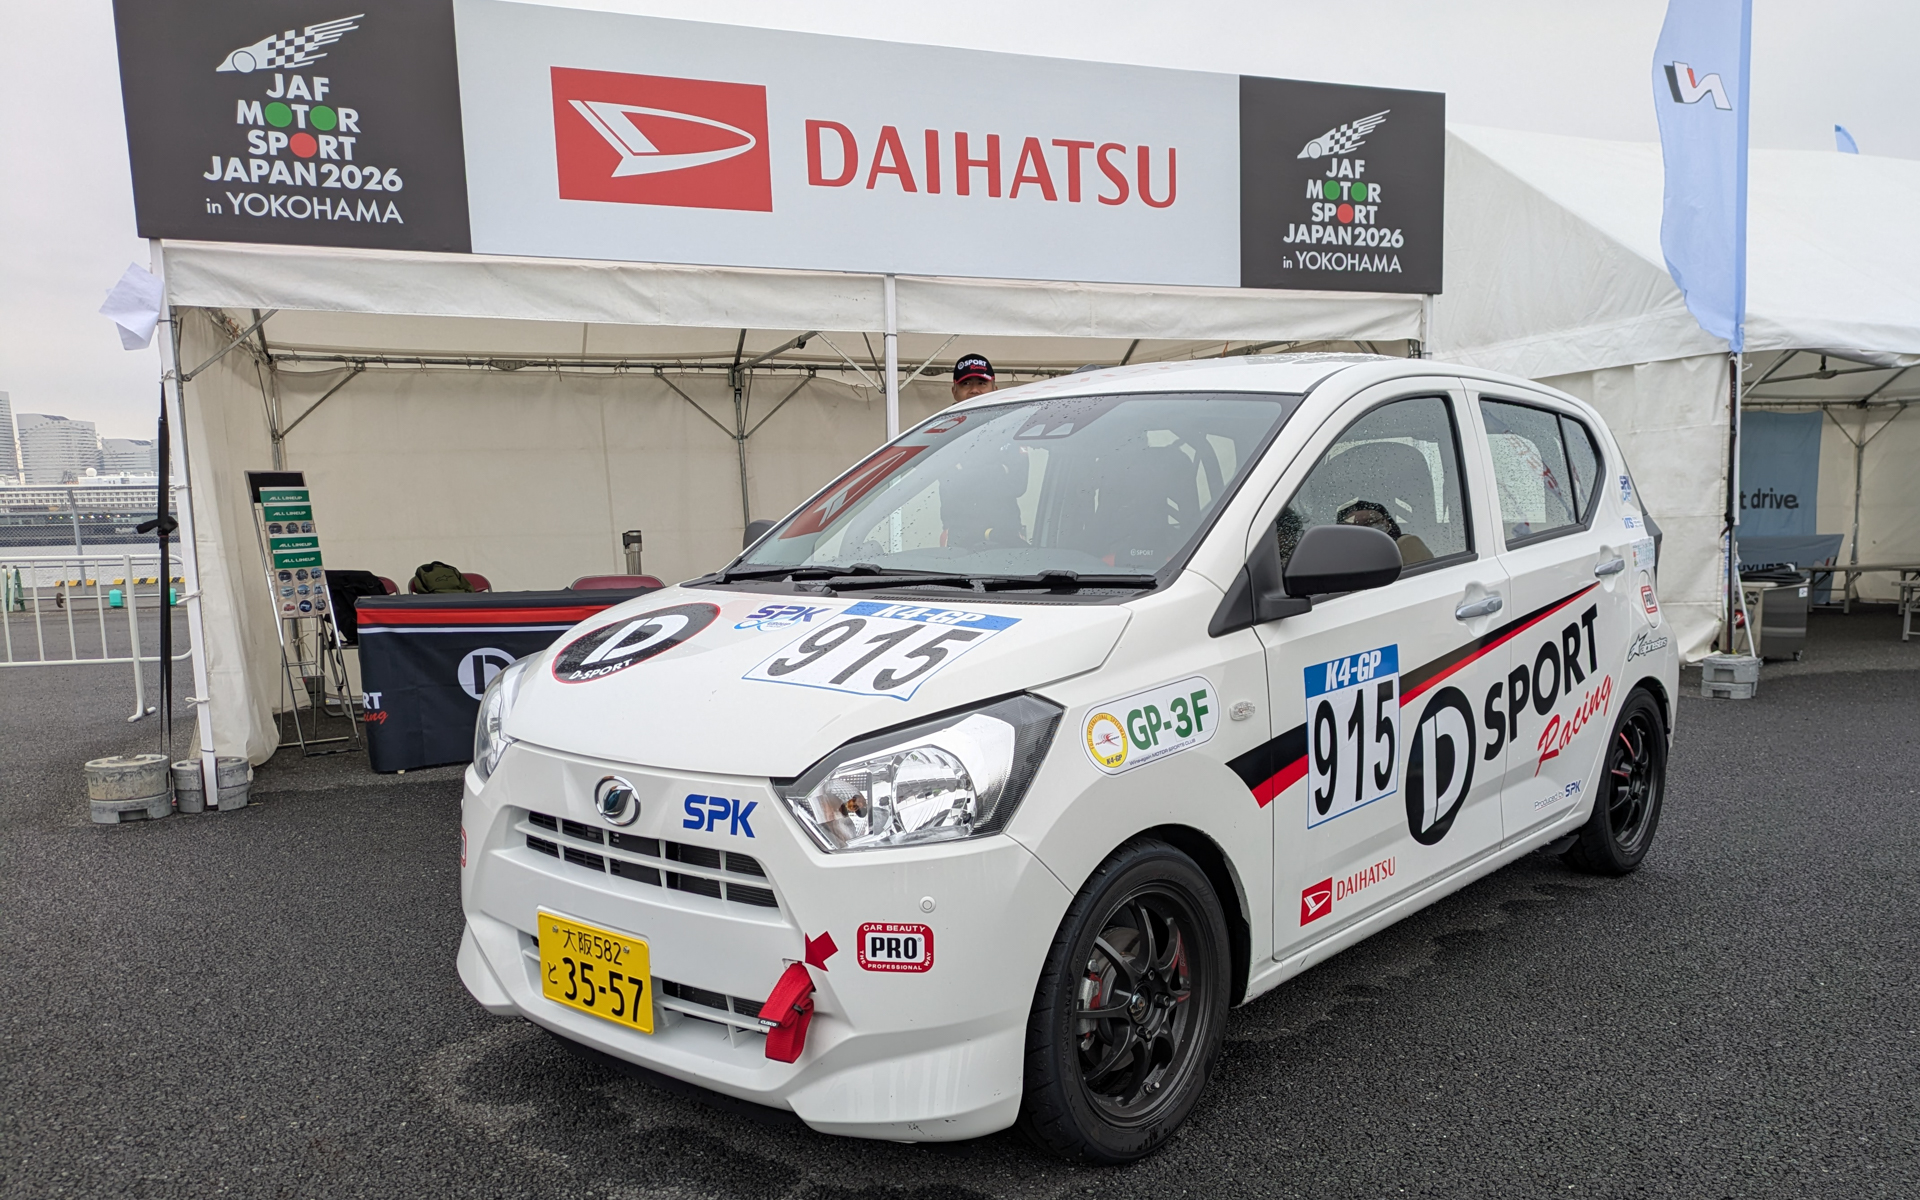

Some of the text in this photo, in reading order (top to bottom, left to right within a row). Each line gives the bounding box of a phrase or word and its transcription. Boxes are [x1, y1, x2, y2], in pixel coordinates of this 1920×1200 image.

[266, 73, 330, 101] JAF
[236, 100, 361, 133] MOTOR
[247, 129, 356, 160] SPORT
[804, 118, 1177, 208] DAIHATSU
[1325, 157, 1366, 179] JAF
[1306, 178, 1382, 203] MOTOR
[206, 191, 404, 224] in YOKOHAMA
[1311, 202, 1379, 225] SPORT
[1283, 250, 1403, 273] in YOKOHAMA
[964, 359, 987, 367] SPORT
[745, 605, 833, 622] SPK
[873, 604, 986, 625] K4-GP
[569, 658, 632, 680] D-SPORT
[767, 618, 984, 690] 915
[1325, 650, 1381, 691] K4-GP
[1484, 603, 1598, 761] SPORT
[1126, 689, 1209, 750] GP-3F
[1534, 674, 1613, 778] Racing
[1314, 679, 1395, 816] 915
[1564, 780, 1581, 797] SPK
[682, 793, 759, 839] SPK
[1336, 856, 1395, 901] DAIHATSU
[886, 924, 926, 932] BEAUTY
[868, 963, 922, 971] PROFESSIONAL
[547, 957, 643, 1023] と 35-57
